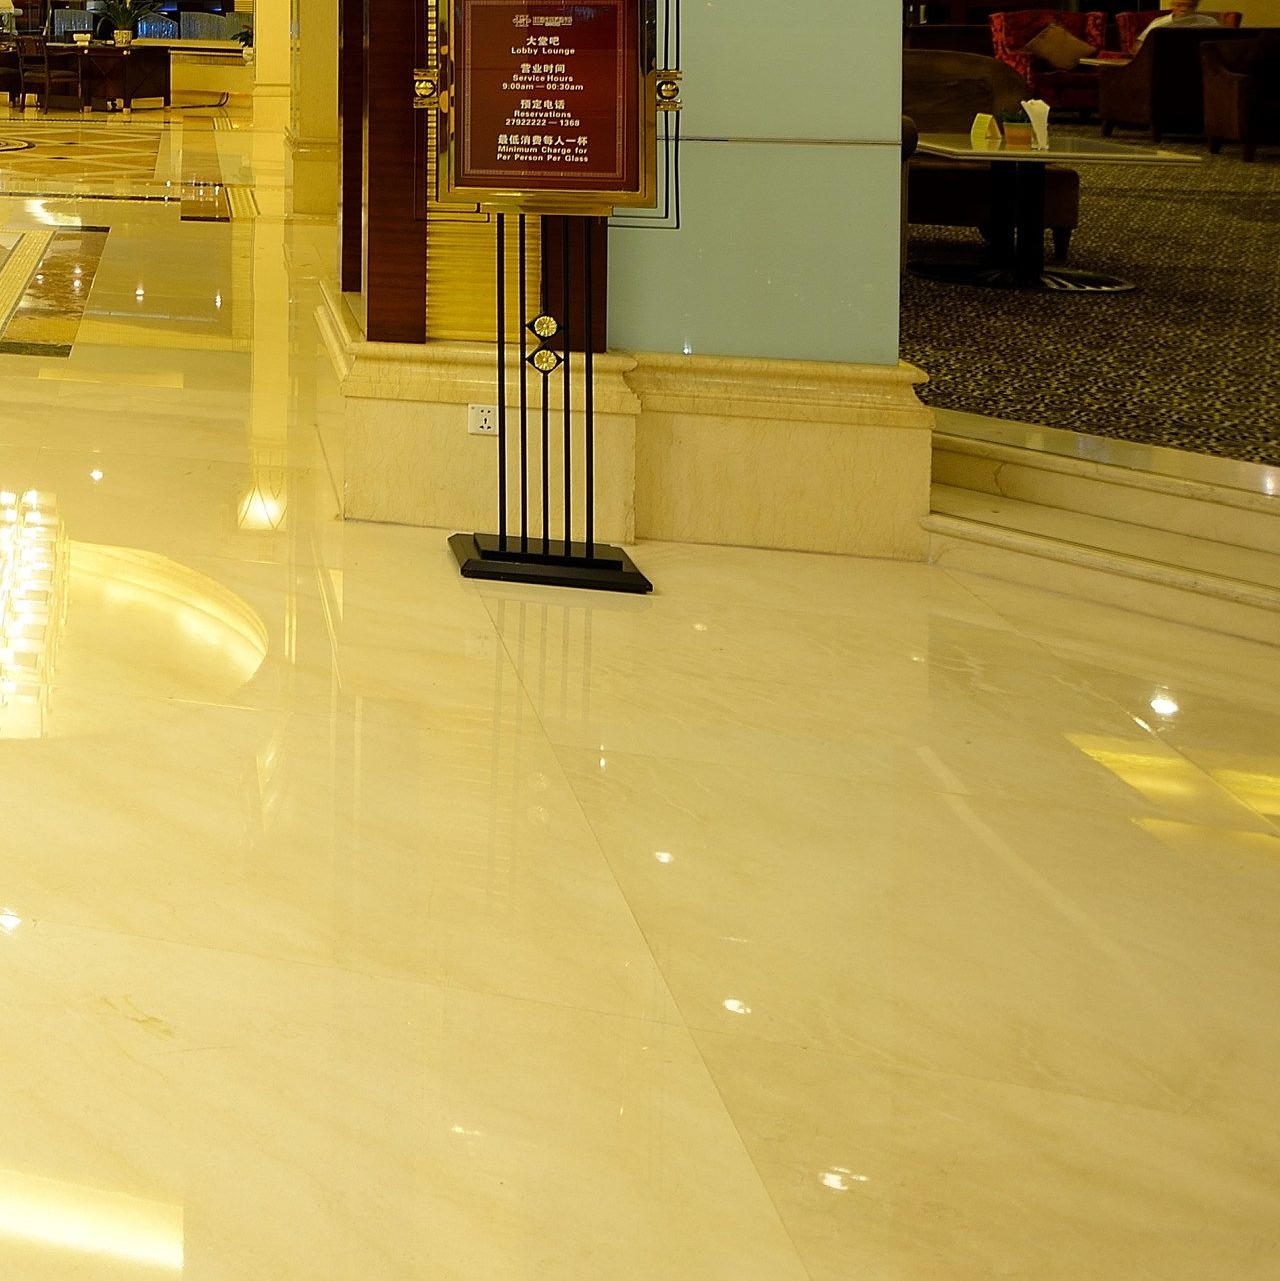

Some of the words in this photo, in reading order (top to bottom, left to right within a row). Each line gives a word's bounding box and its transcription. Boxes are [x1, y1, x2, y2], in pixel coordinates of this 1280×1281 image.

[526, 36, 560, 46] 大堂吧
[511, 47, 538, 55] Lobby
[542, 47, 575, 56] Lounge
[520, 63, 565, 74] 营业时间
[512, 74, 545, 82] Service
[547, 74, 573, 82] Hours
[520, 99, 565, 109] 预定电话
[514, 110, 571, 118] Reservations
[498, 134, 588, 146] 最低消费每人一杯
[497, 145, 537, 153] Minimum
[541, 146, 572, 154] Charge
[575, 146, 588, 154] for
[497, 153, 511, 161] Per
[547, 154, 561, 162] Per
[565, 154, 588, 162] Glass
